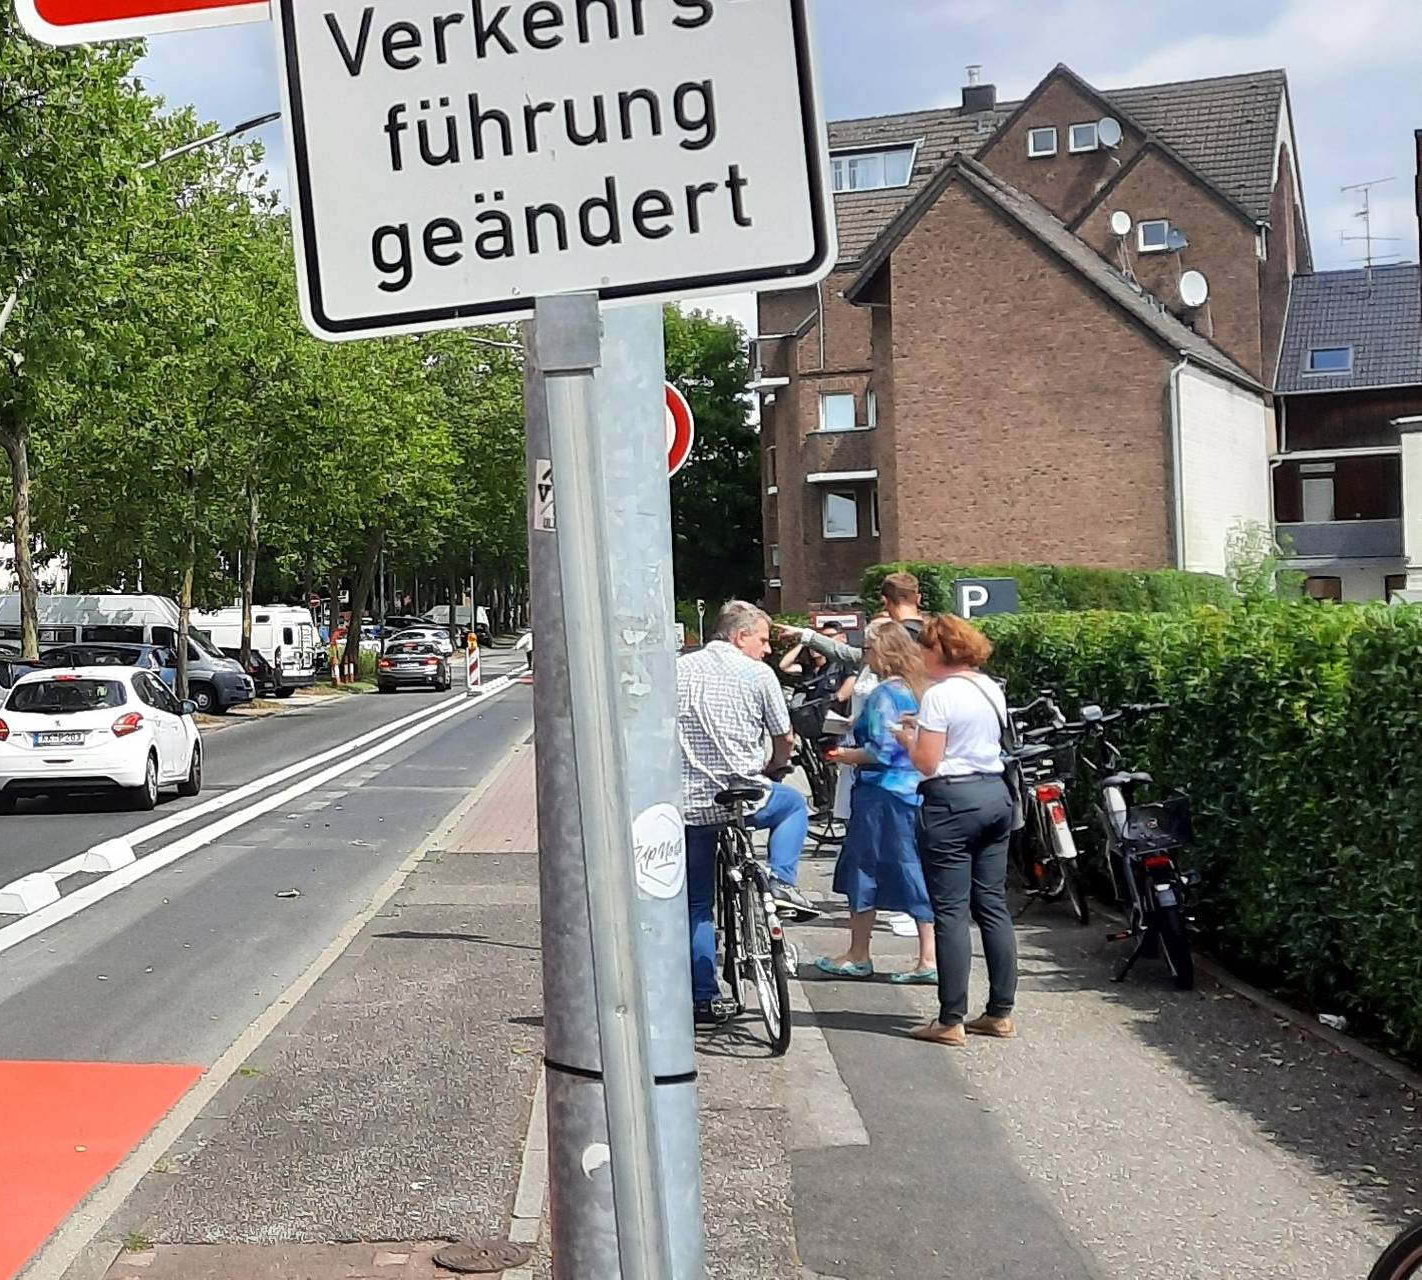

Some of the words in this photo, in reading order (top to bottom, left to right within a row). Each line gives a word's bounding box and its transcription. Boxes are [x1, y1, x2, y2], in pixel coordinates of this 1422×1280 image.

[383, 79, 717, 172] führung
[370, 163, 752, 294] geändert
[962, 585, 989, 619] P
